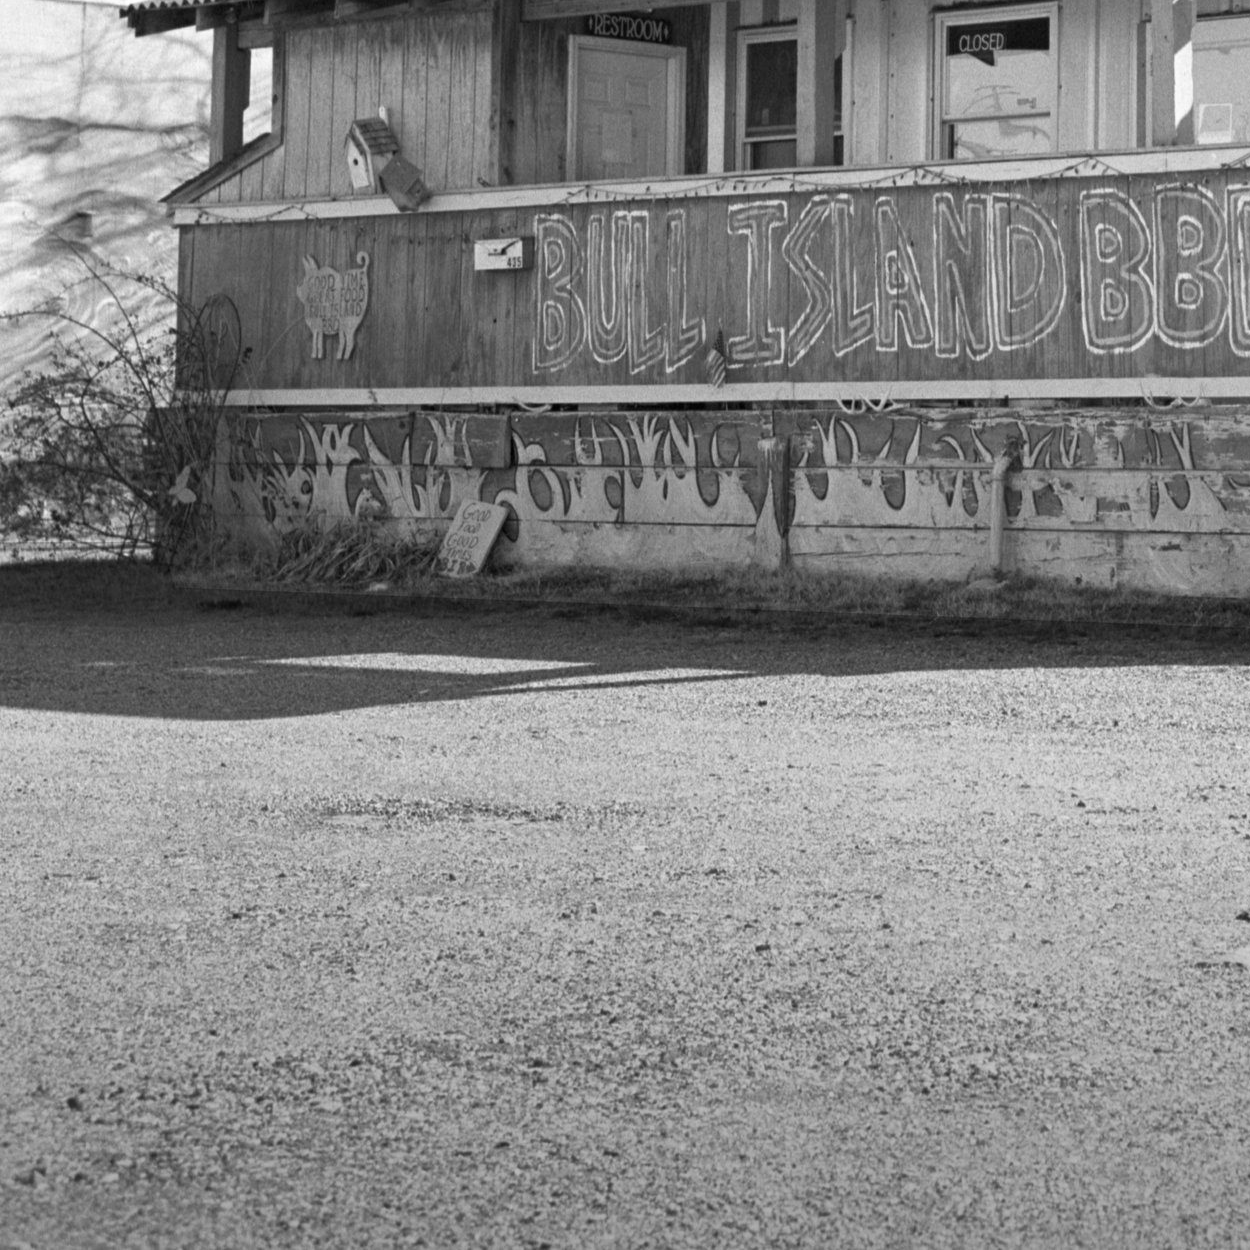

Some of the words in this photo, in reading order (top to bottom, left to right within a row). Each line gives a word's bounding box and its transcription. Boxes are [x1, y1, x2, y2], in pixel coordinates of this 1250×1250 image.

[593, 14, 664, 42] RESTROOM
[958, 33, 1005, 52] CLOSED
[307, 273, 335, 290] GOOD
[532, 208, 706, 375] BULL
[726, 193, 1067, 369] ISLAND
[340, 287, 366, 303] FOOD
[462, 502, 492, 523] GOOD
[446, 532, 479, 549] GOOD
